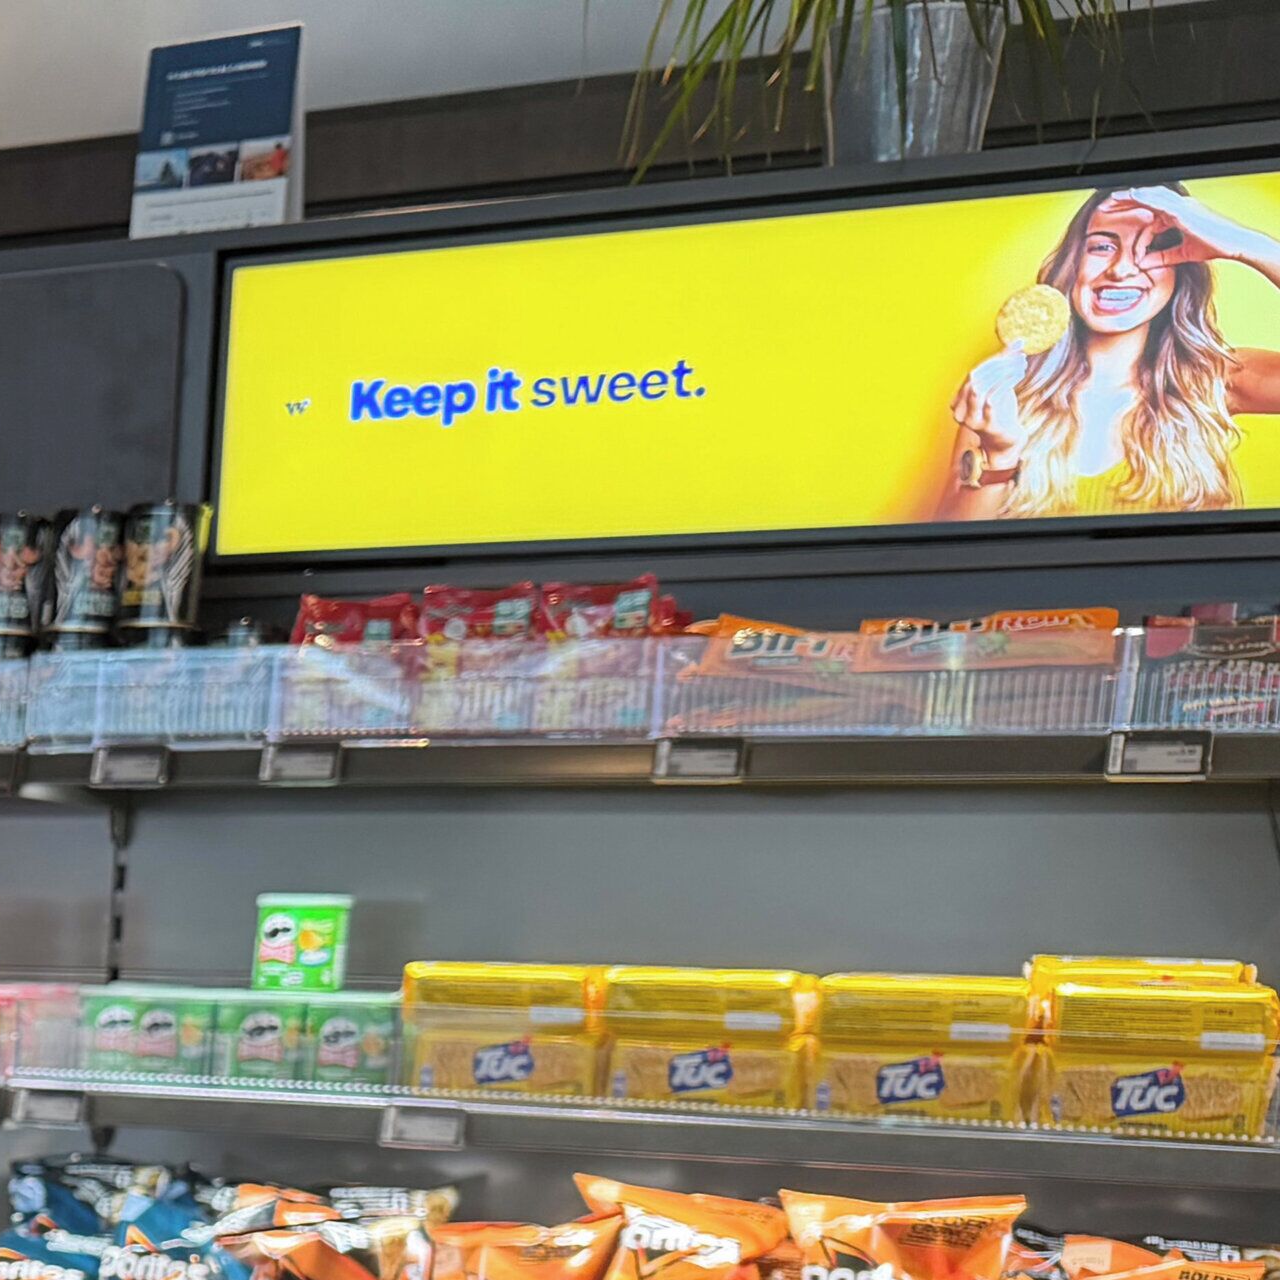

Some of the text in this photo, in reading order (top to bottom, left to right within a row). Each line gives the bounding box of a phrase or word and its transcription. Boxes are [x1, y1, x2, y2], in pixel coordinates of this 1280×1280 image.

[350, 360, 706, 425] Keep it sweet.
[475, 1055, 530, 1082] TUC
[672, 1059, 728, 1088] TUC
[880, 1066, 942, 1099] TUC
[1115, 1074, 1179, 1111] TUC
